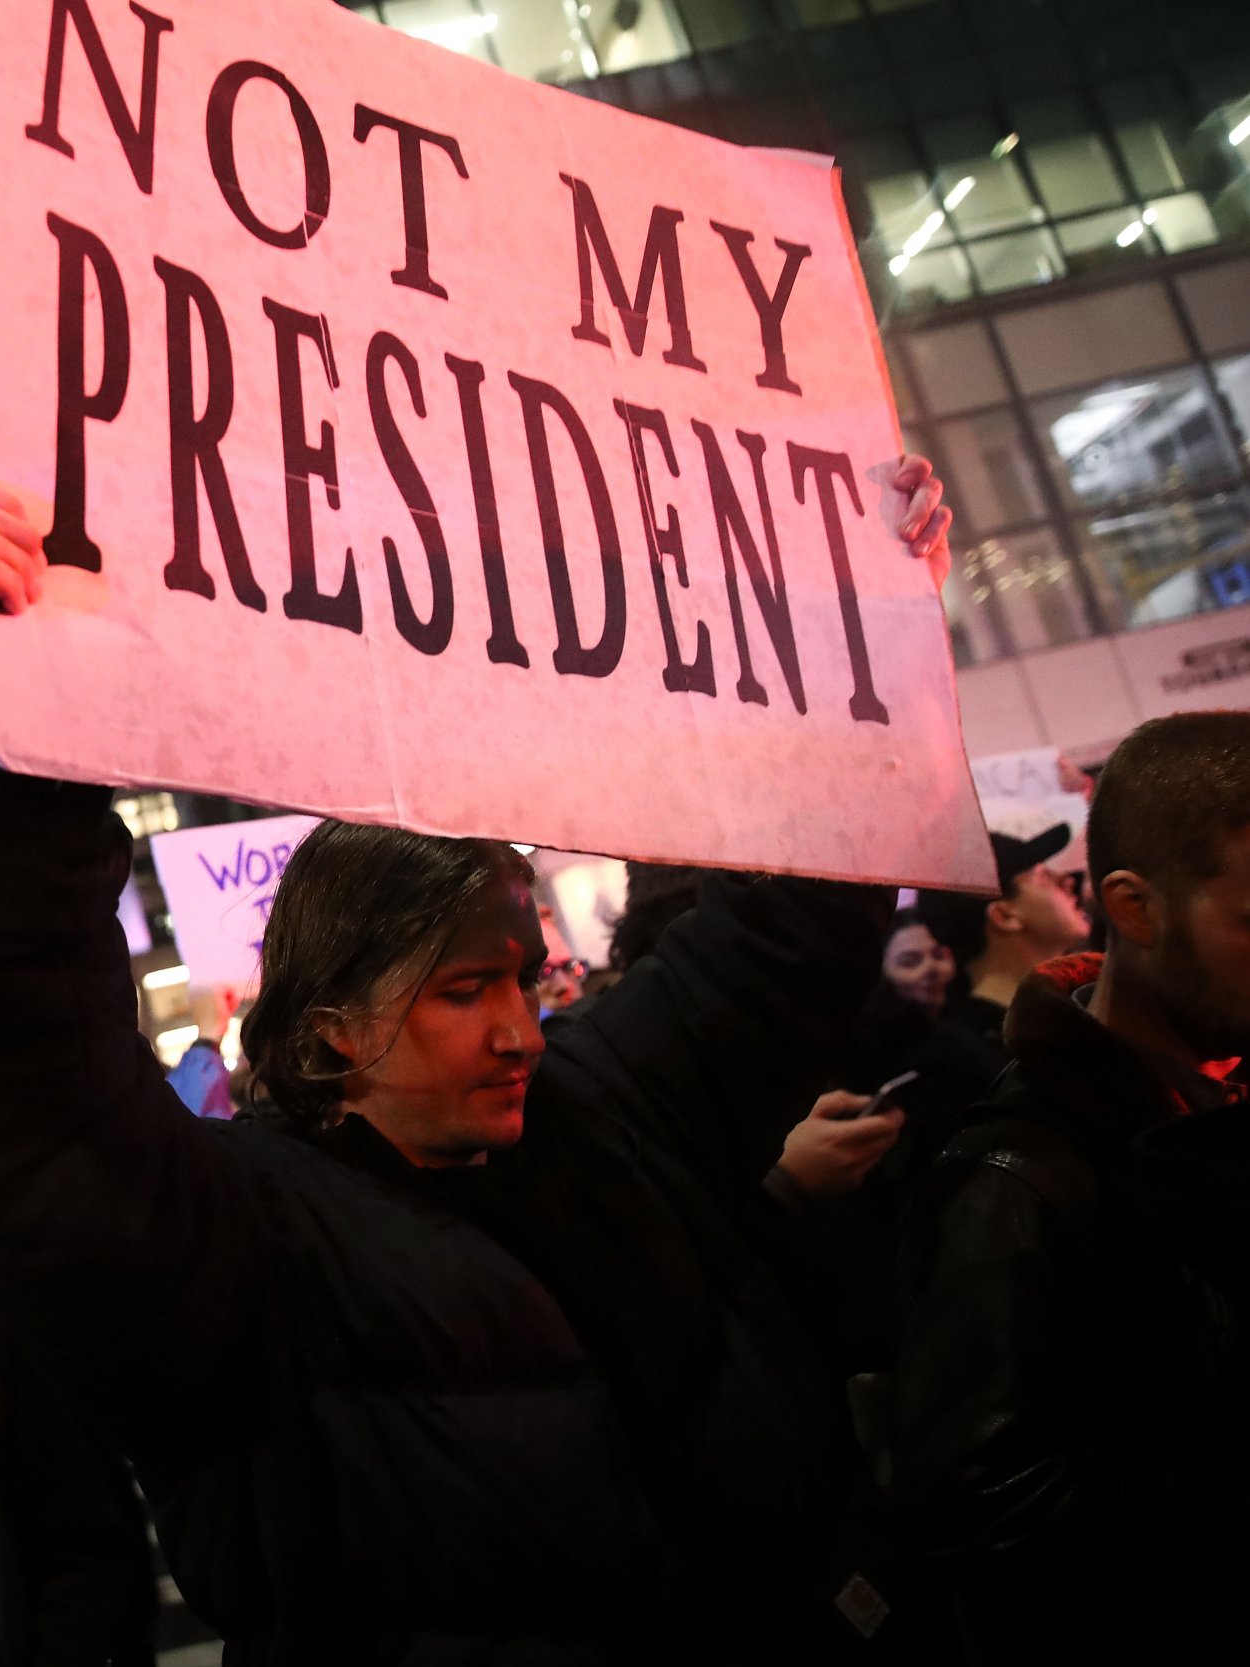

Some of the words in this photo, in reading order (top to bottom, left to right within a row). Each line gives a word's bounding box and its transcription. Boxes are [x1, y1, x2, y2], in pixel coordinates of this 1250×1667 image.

[25, 0, 469, 301] NOT
[559, 171, 812, 397] MY
[42, 210, 890, 726] PRESIDENT
